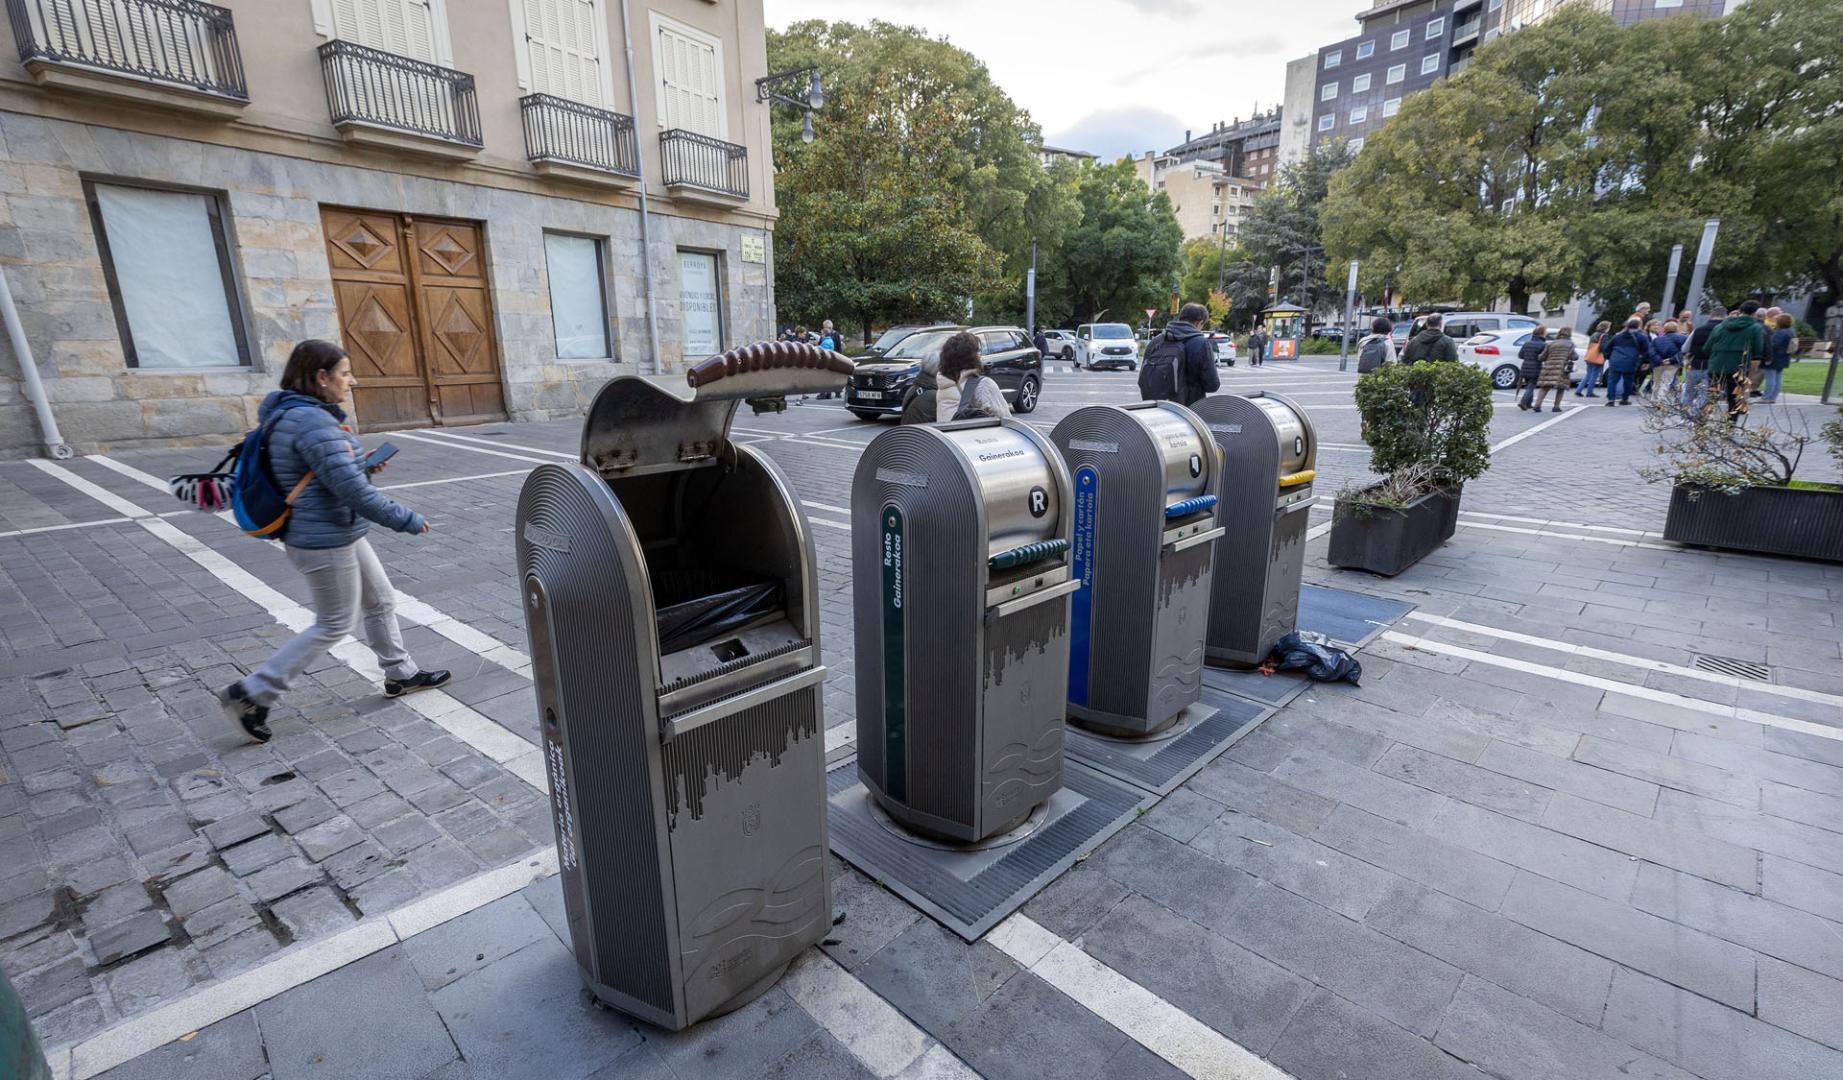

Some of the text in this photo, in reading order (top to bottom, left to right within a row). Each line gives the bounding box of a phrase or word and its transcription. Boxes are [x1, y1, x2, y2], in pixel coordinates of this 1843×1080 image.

[979, 449, 1025, 462] Gainerakoa
[1032, 491, 1045, 512] R
[1076, 532, 1084, 560] Papel
[893, 534, 902, 608] Gainerakoa
[1083, 550, 1092, 586] Papera
